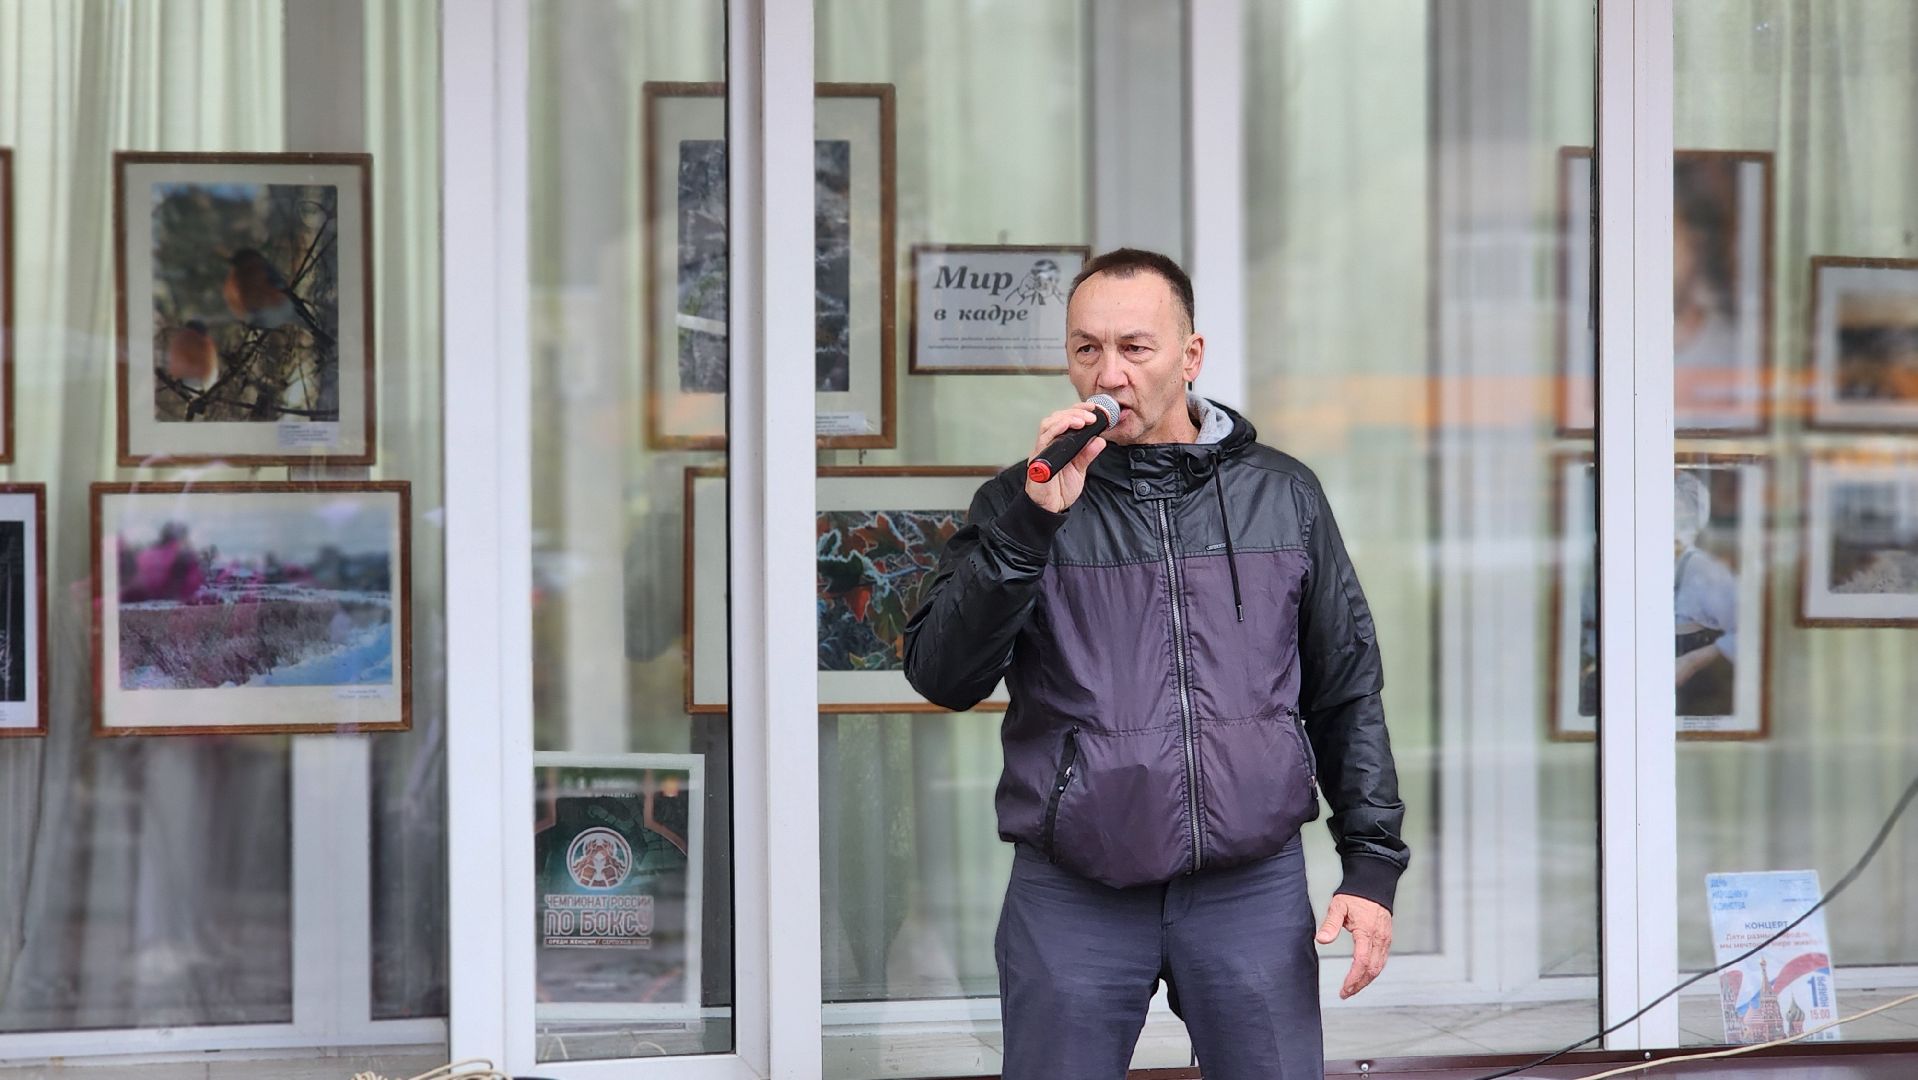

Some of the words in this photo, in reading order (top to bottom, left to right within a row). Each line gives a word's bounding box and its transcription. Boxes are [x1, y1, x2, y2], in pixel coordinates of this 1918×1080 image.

[934, 265, 1013, 296] Мир
[934, 308, 947, 321] в
[958, 304, 1029, 326] кадре
[545, 895, 607, 908] ЧЕМПИОНАТ
[610, 895, 652, 909] РОССИИ
[545, 910, 574, 935] ПО
[581, 910, 653, 936] БОКСУ
[1745, 921, 1788, 930] КОНЦЕРТ
[1807, 975, 1818, 1008] 1
